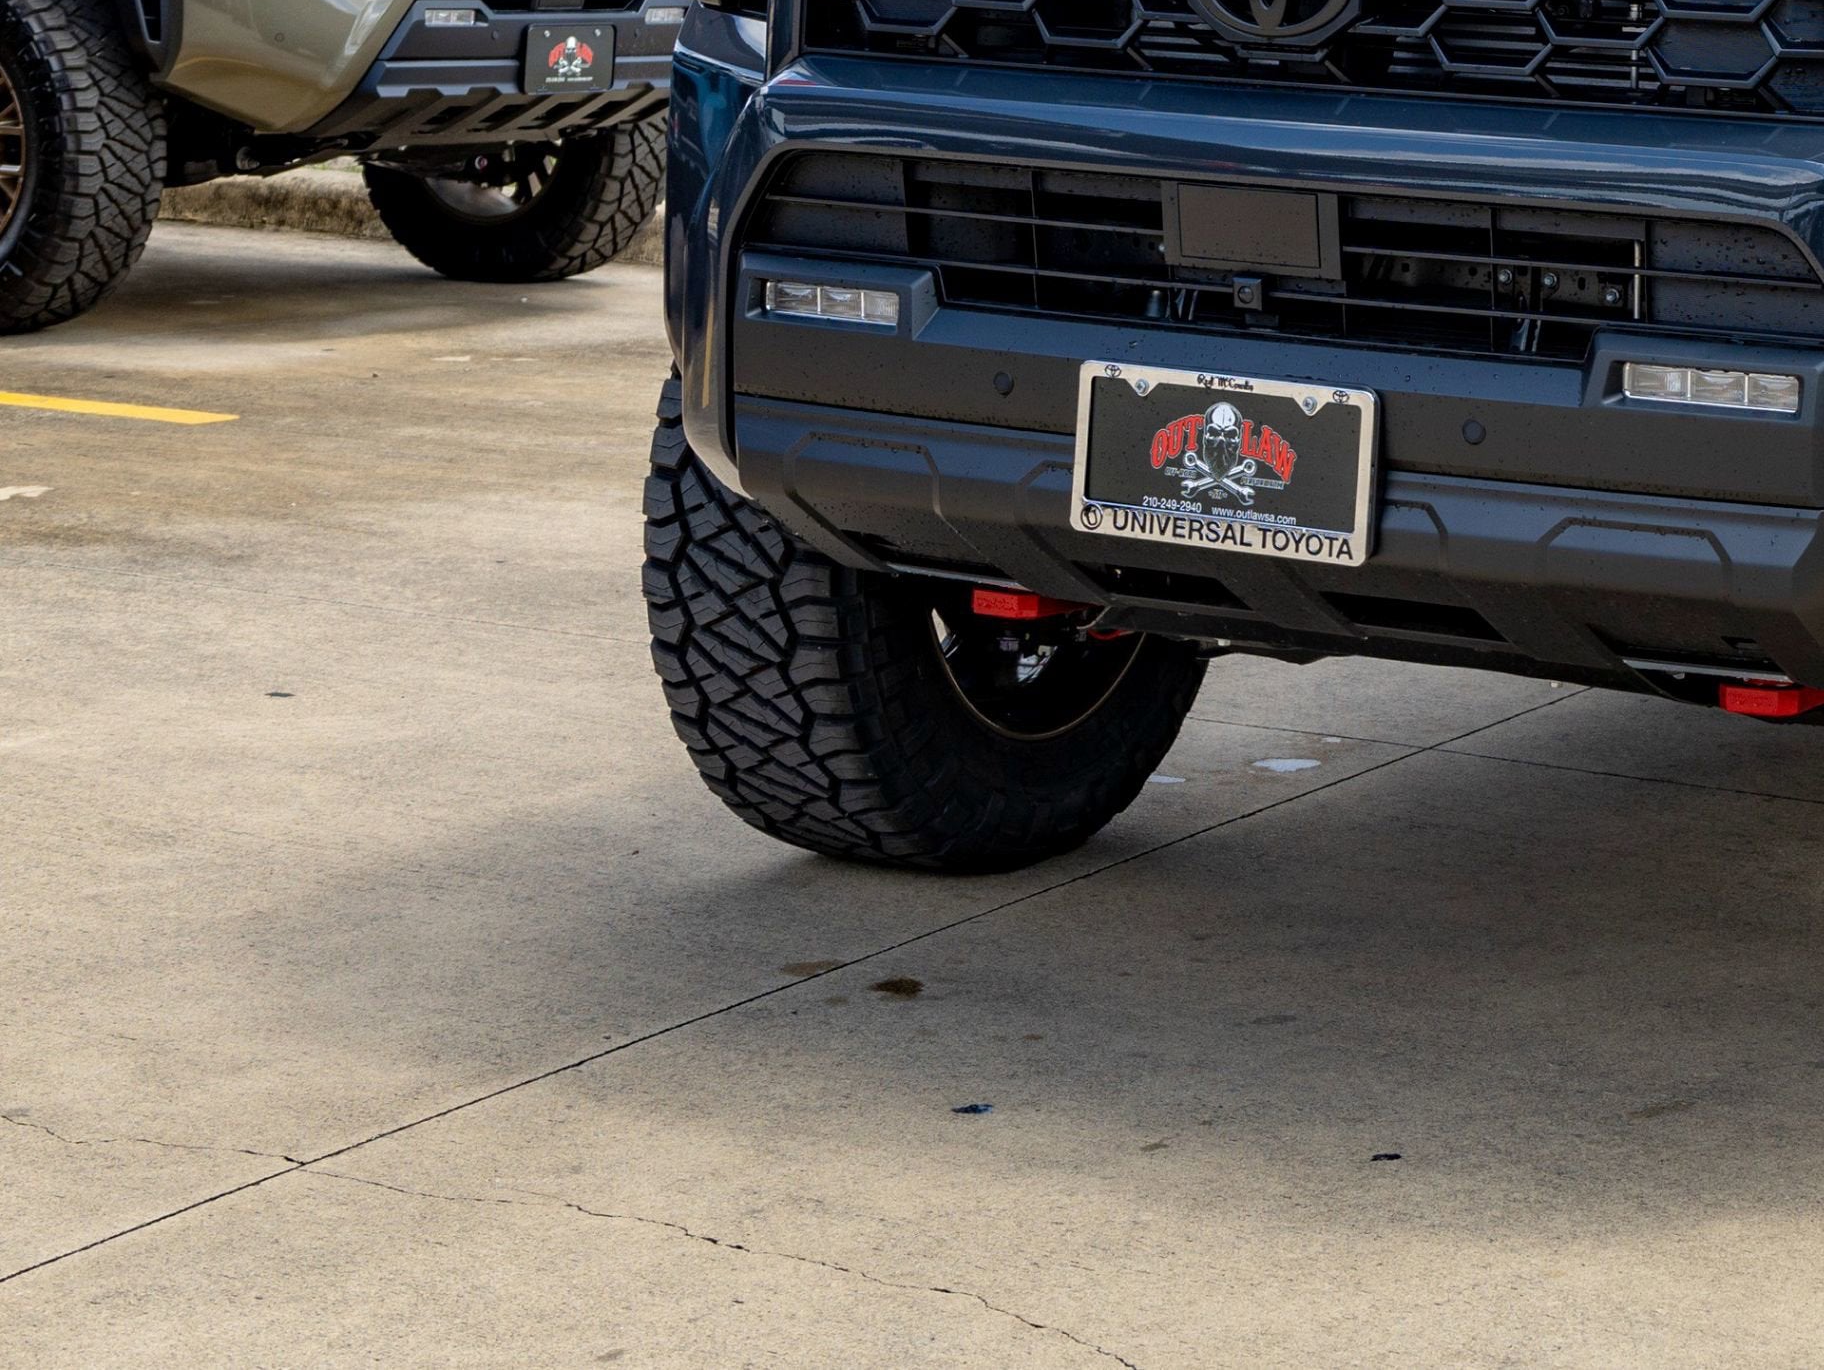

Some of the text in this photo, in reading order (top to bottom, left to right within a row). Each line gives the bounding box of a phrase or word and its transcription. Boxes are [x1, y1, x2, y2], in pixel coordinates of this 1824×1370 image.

[1142, 496, 1297, 524] 210-249-2940 www.outlawsa.com
[1112, 508, 1253, 547] UNIVERSAL
[1259, 528, 1354, 561] TOYOTA
